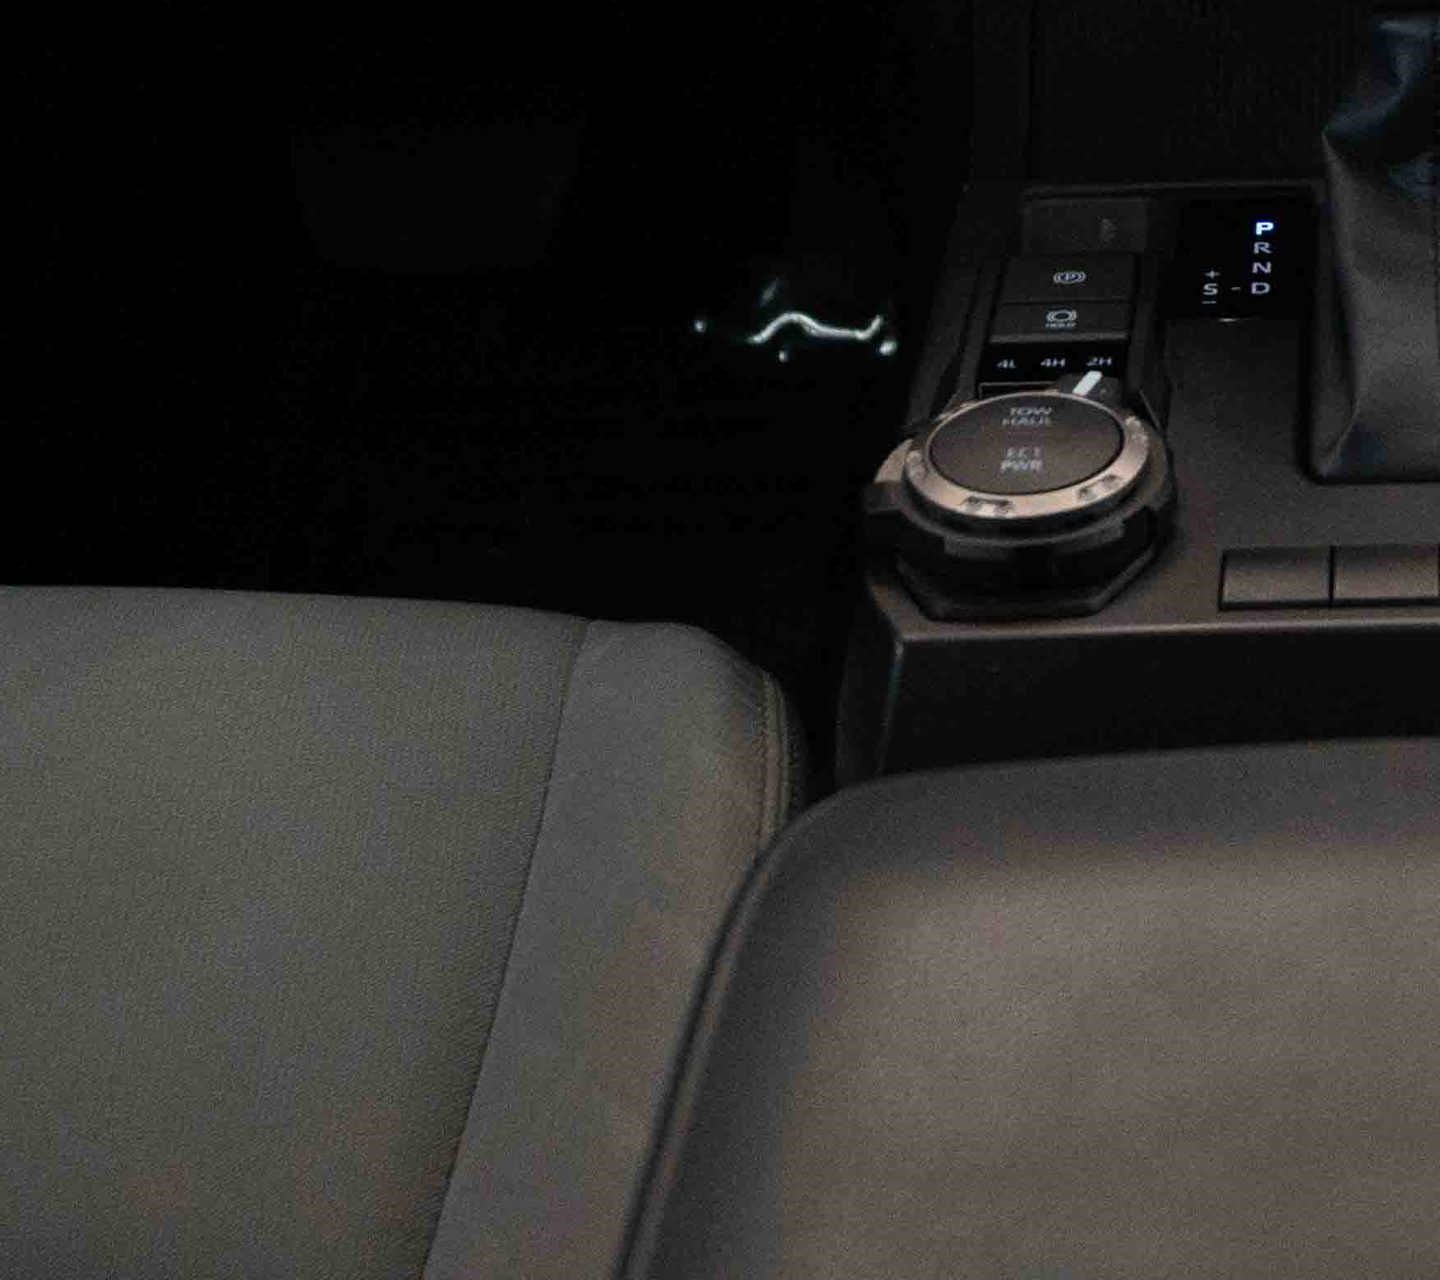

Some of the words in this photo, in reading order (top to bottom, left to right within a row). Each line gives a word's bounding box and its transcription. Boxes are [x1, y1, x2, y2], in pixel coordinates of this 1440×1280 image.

[1255, 221, 1275, 236] P
[1253, 241, 1272, 255] R
[1252, 261, 1272, 274] N
[1202, 282, 1219, 296] S
[1250, 281, 1271, 295] D
[1009, 406, 1054, 416] TOW
